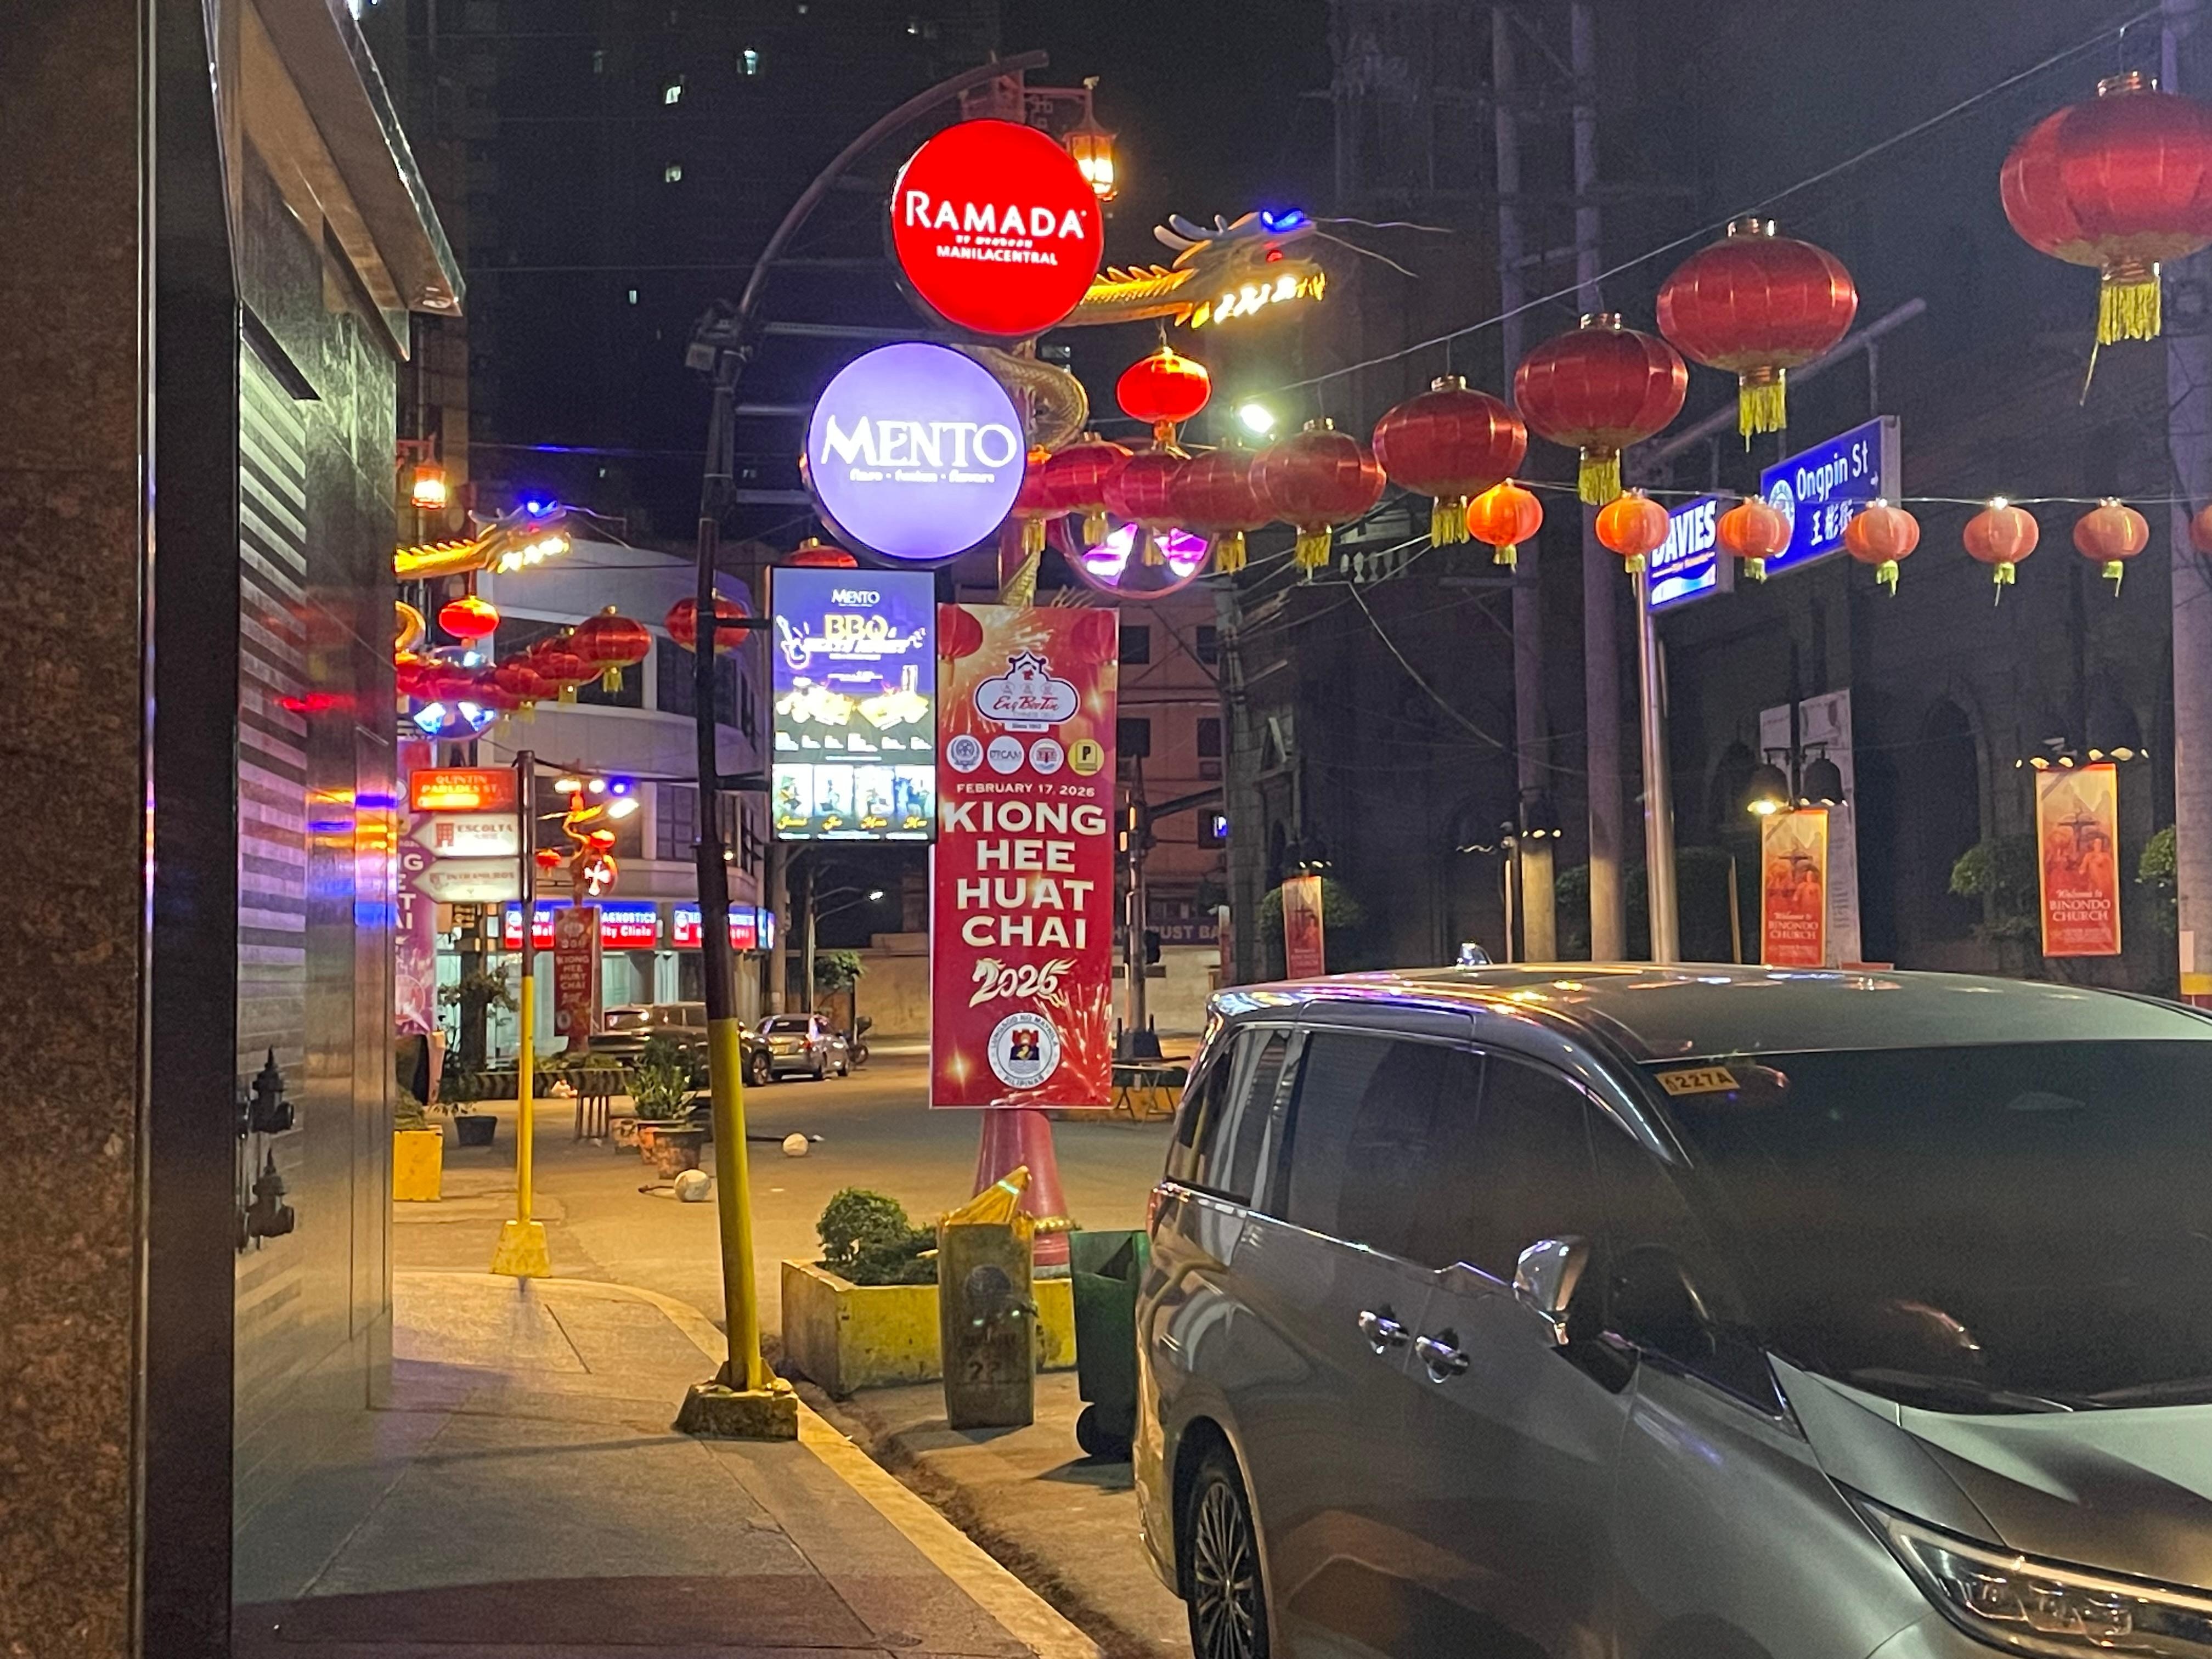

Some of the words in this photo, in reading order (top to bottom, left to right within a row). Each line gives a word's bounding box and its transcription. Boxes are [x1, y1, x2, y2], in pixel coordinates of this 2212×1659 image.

[905, 190, 1085, 239] RAMADA
[821, 414, 1017, 468] MENTO
[1797, 453, 1848, 503] Ongpin
[1853, 440, 1868, 477] St
[831, 589, 880, 604] MENTO
[825, 614, 889, 641] BBQ
[1082, 746, 1091, 760] P
[957, 783, 1033, 793] FEBRUARY
[1059, 785, 1094, 797] 2026
[458, 824, 513, 832] ESCOLTA
[944, 800, 1106, 836] KIONG
[976, 839, 1076, 873] HEE
[957, 877, 1094, 912] HUAT
[2050, 899, 2111, 910] BINONDO
[961, 915, 1087, 950] CHAI
[2052, 911, 2108, 922] CHURCH
[969, 957, 1077, 1009] 2026
